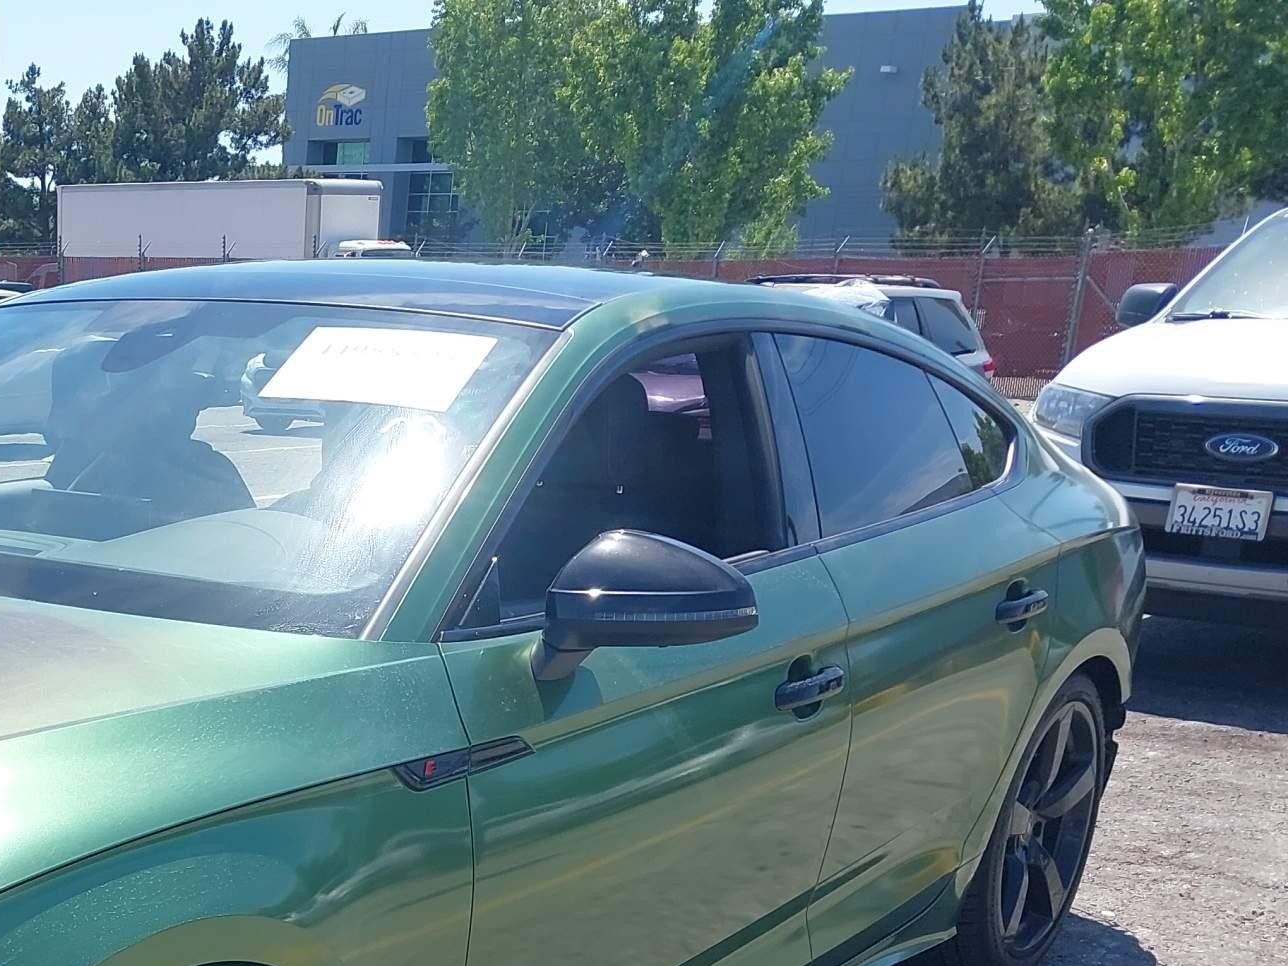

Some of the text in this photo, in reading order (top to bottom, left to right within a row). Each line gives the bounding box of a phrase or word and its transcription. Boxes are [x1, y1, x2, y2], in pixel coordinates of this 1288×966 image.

[316, 104, 362, 126] OnTrac
[1219, 438, 1260, 455] Ford
[1175, 505, 1261, 531] 34251S3
